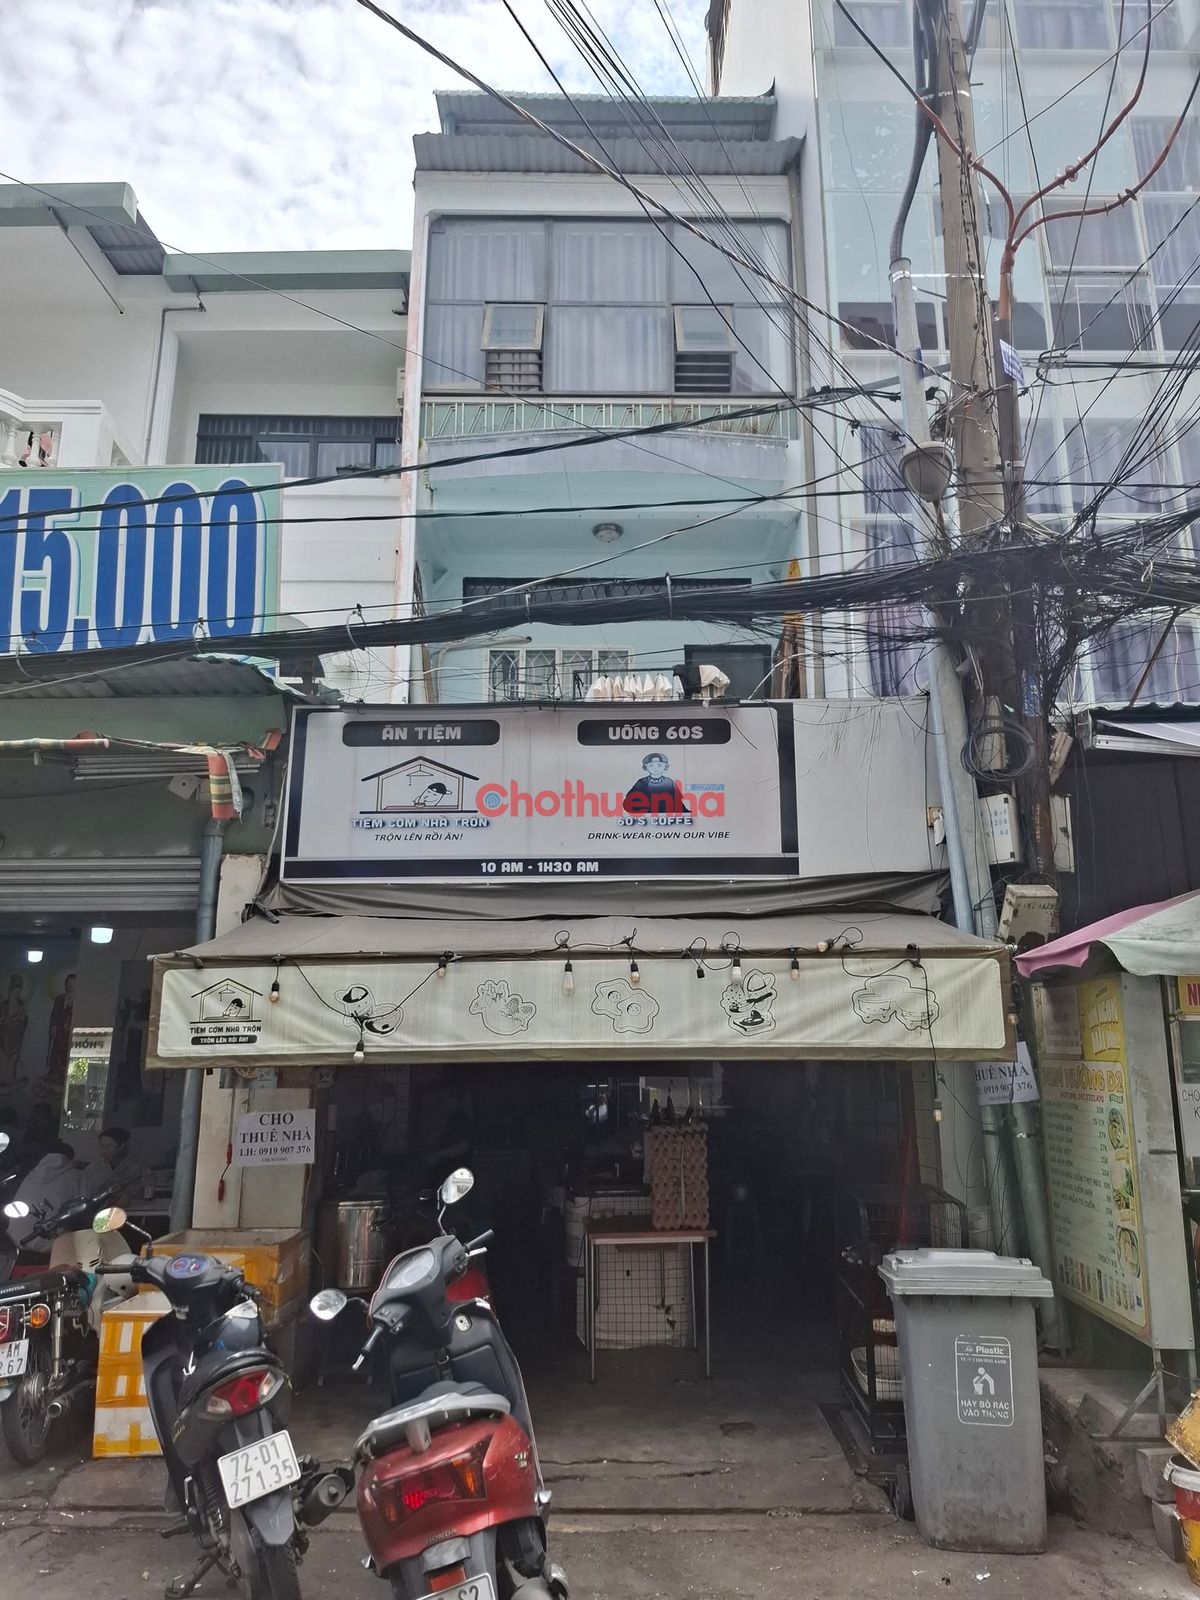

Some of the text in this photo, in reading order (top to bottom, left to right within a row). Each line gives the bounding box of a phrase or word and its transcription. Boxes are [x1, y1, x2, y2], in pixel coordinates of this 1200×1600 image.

[382, 725, 462, 742] ĂN TIỆM
[608, 723, 703, 740] UỐNG 60S
[651, 815, 692, 825] COFFE
[588, 832, 680, 840] DRINK-WEAR-OWN
[708, 831, 730, 839] VIBE
[480, 863, 497, 873] 10
[501, 862, 523, 872] AM
[537, 862, 572, 872] 1H30
[577, 861, 599, 872] AM
[975, 1065, 996, 1081] HUÊ
[1016, 1082, 1032, 1091] 376
[260, 1112, 294, 1125] CHO
[240, 1127, 312, 1143] THUÊ NHÀ
[240, 1148, 256, 1156] LH:
[258, 1147, 278, 1155] 0919
[280, 1146, 294, 1154] 907
[976, 1346, 1004, 1354] Plastic
[231, 1458, 294, 1503] 271.35
[425, 1529, 457, 1544] HONDA
